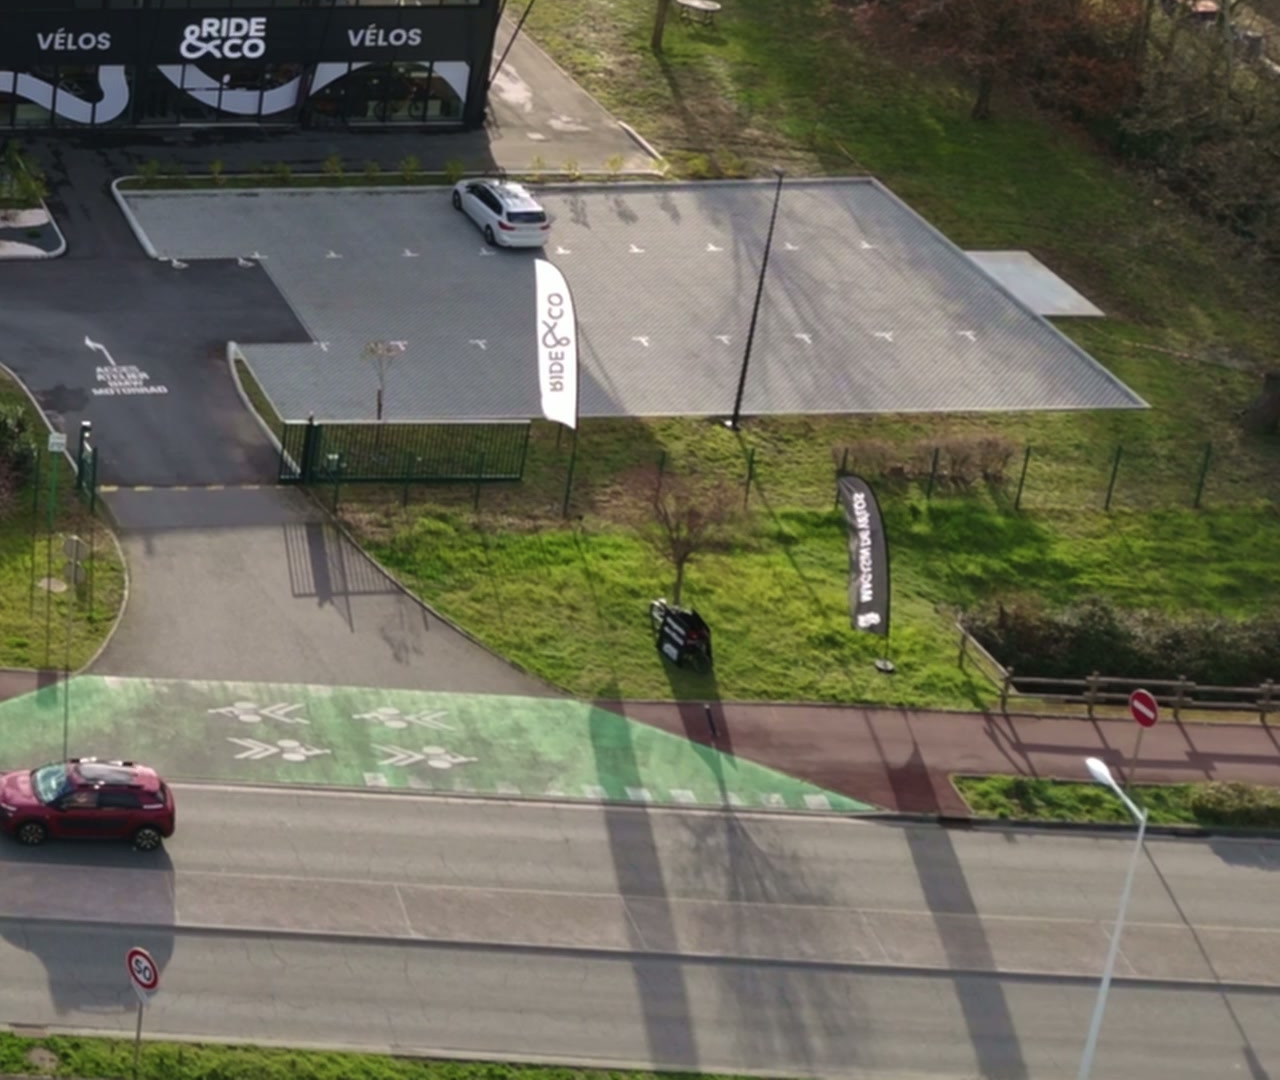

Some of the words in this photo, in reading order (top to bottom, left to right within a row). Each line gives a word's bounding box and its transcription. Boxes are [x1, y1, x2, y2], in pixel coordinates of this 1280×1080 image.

[37, 28, 111, 50] VÉLOS
[201, 18, 267, 38] RIDE
[347, 23, 422, 47] VÉLOS
[134, 958, 152, 982] 50
